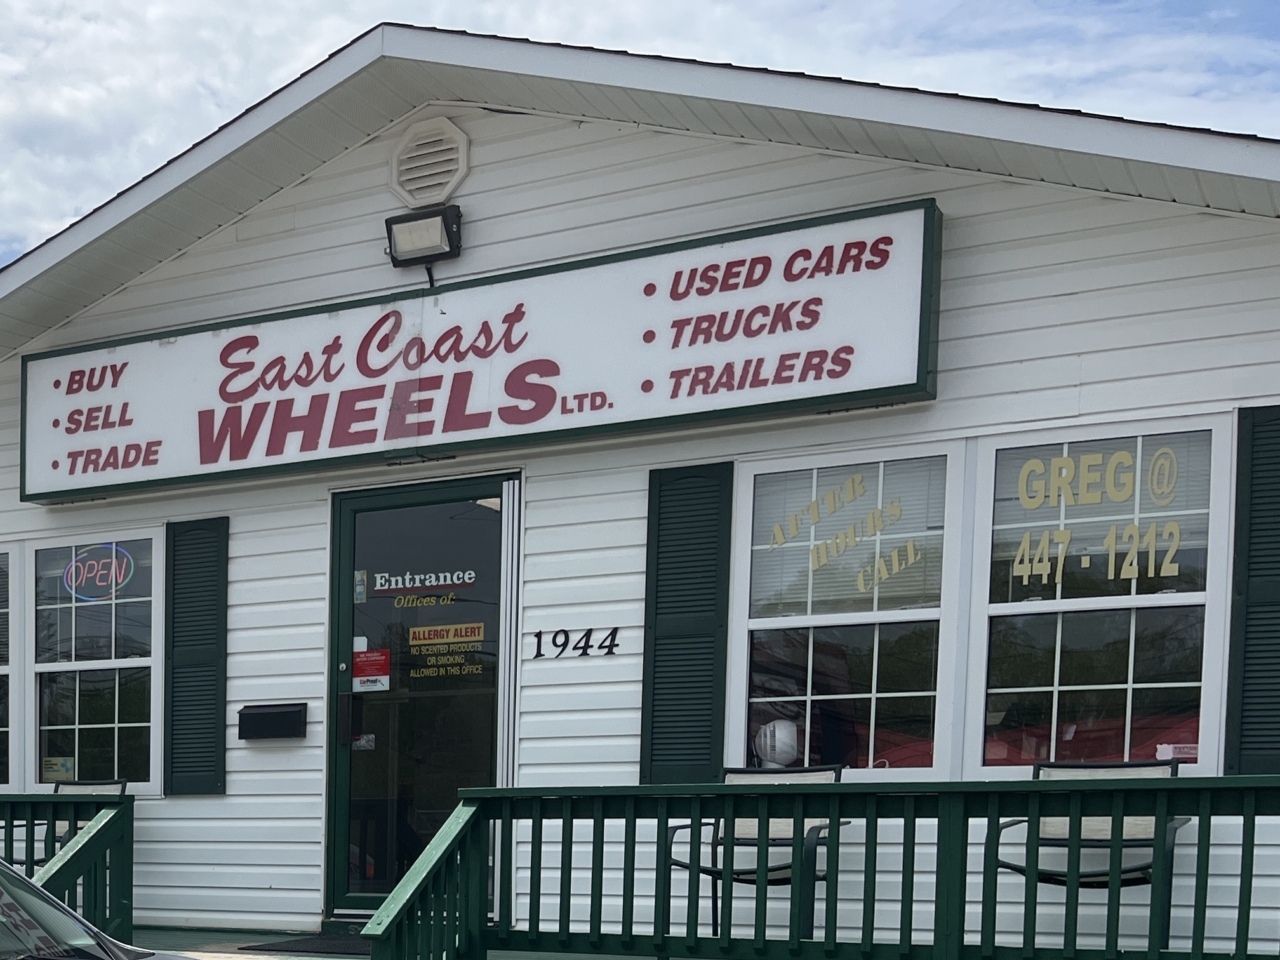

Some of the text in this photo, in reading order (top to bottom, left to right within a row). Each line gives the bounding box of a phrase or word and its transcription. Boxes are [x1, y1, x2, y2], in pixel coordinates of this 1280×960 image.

[670, 236, 893, 301] USED CARS
[670, 297, 823, 349] TRUCKS
[219, 303, 528, 404] East Coast
[64, 362, 129, 395] BUY
[669, 345, 854, 399] TRAILERS
[64, 404, 134, 435] SELL
[197, 359, 614, 465] WHEELS LTD.
[66, 440, 162, 475] TRADE
[1018, 447, 1179, 510] GREG @
[769, 473, 867, 551] AFTER
[810, 496, 902, 571] HOURS
[67, 557, 127, 587] OPEN
[374, 570, 476, 590] Entrance
[857, 539, 921, 592] CALL
[394, 592, 456, 608] Offices of:
[411, 626, 482, 641] ALLERGY ALERT
[411, 642, 482, 655] NO SCENTED PRODUCTS
[532, 627, 620, 659] 1944
[410, 665, 482, 678] ALLOWED IN THIS OFFICE
[427, 655, 465, 666] OR SMOKING
